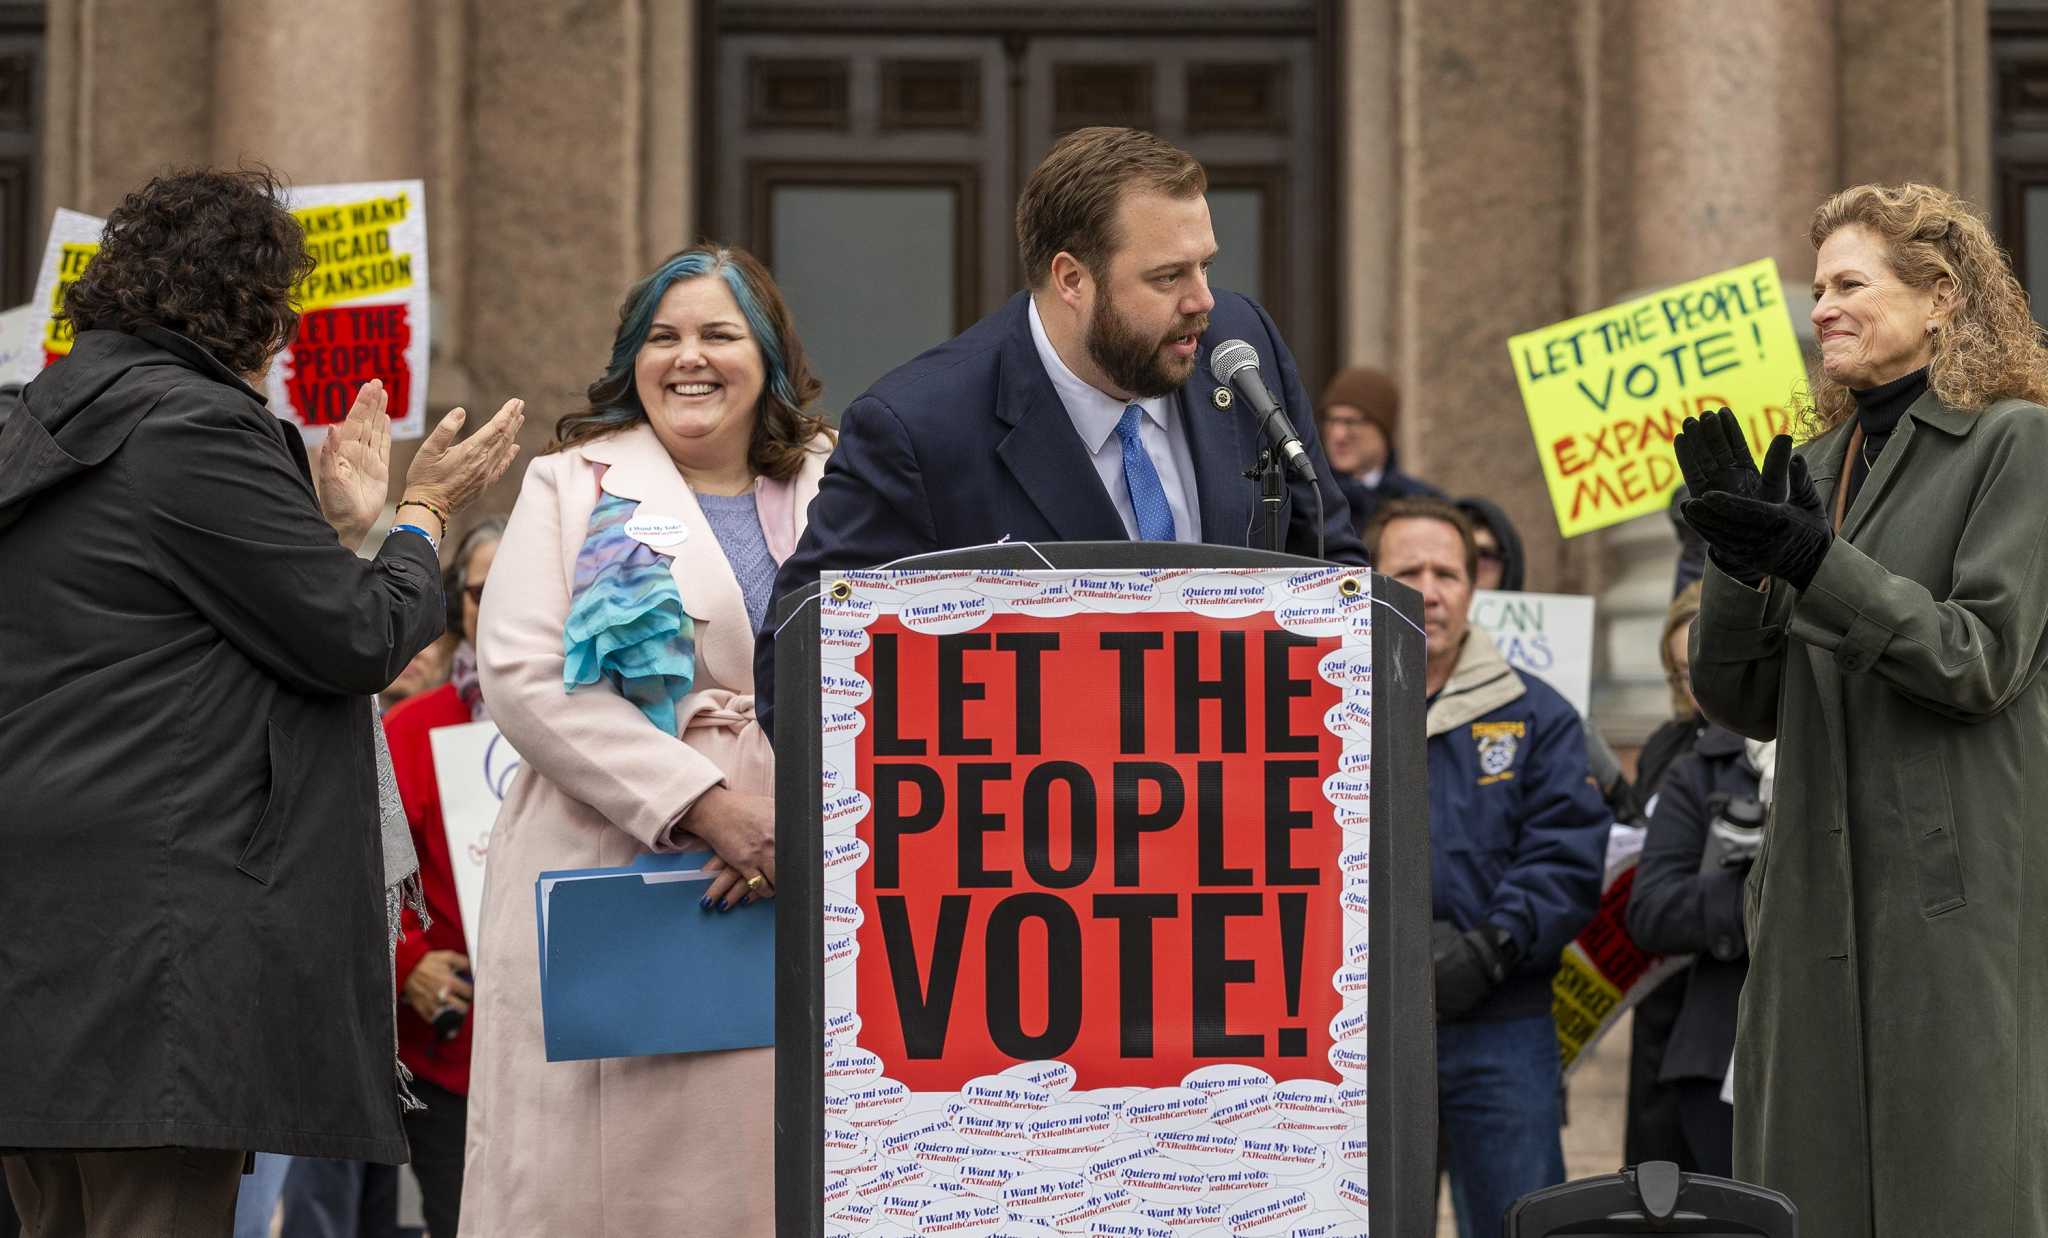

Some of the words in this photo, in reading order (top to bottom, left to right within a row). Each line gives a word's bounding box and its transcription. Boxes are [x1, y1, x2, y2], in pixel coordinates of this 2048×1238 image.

[306, 210, 342, 235] ANS
[353, 194, 408, 226] WANT
[305, 230, 390, 265] DICAID
[307, 254, 412, 298] PANSION
[351, 309, 401, 340] THE
[1524, 329, 1586, 382] LET
[1591, 305, 1657, 354] THE
[1660, 271, 1776, 334] PEOPLE
[295, 344, 401, 380] PEOPLE
[976, 576, 1040, 588] HealthCareVoter
[1080, 579, 1107, 590] Want
[1109, 580, 1126, 592] My
[1128, 582, 1154, 592] Vote!
[1287, 570, 1324, 588] ¡Quiero
[1073, 590, 1153, 601] #TXHealthCareVoter
[1183, 587, 1225, 597] ¡Quiero
[1227, 586, 1238, 596] mi
[1240, 586, 1265, 595] voto!
[847, 600, 872, 610] Vote!
[912, 607, 939, 617] Want
[941, 603, 958, 614] My
[960, 598, 985, 607] Vote!
[1185, 597, 1264, 605] #TXHealthCareVoter
[908, 609, 986, 626] #TXHealthCareVoter
[1280, 607, 1319, 618] ¡Quiero
[1322, 607, 1335, 615] mi
[1473, 600, 1545, 633] CAN
[838, 629, 863, 639] Vote!
[821, 676, 837, 686] My
[840, 678, 865, 688] Vote!
[873, 632, 1060, 756] LET
[1100, 630, 1319, 754] THE
[831, 712, 856, 723] Vote!
[1337, 782, 1362, 791] Want
[836, 793, 861, 806] Vote!
[873, 760, 1320, 889] PEOPLE
[835, 840, 859, 853] Vote!
[834, 906, 858, 915] voto!
[827, 937, 850, 951] Vote!
[876, 892, 1308, 1060] VOTE!
[829, 1012, 852, 1027] Vote!
[1341, 1013, 1364, 1030] Want
[836, 1058, 849, 1067] mi
[851, 1056, 876, 1066] voto!
[1043, 1066, 1067, 1079] voto!
[1187, 1080, 1225, 1089] ¡Quiero
[1228, 1077, 1240, 1086] mi
[1242, 1076, 1269, 1085] voto!
[862, 1090, 876, 1099] mi
[878, 1085, 903, 1096] voto!
[974, 1087, 1001, 1097] Want
[1004, 1089, 1021, 1100] My
[1024, 1093, 1049, 1102] Vote!
[1273, 1091, 1312, 1103] ¡Quiero
[1314, 1094, 1326, 1103] mi
[855, 1097, 903, 1109] lthCareVoter
[1126, 1104, 1165, 1117] ¡Quiero
[1167, 1101, 1180, 1110] mi
[1182, 1096, 1208, 1106] voto!
[1235, 1101, 1248, 1111] mi
[1028, 1119, 1068, 1132] ¡Quiero
[1069, 1116, 1082, 1125] mi
[1085, 1111, 1110, 1123] voto!
[1130, 1108, 1208, 1124] #TXHealthCareVoter
[965, 1118, 993, 1127] Want
[995, 1119, 1012, 1130] My
[1032, 1122, 1110, 1140] #TXHealthCareVoter
[834, 1130, 859, 1140] Vote!
[882, 1131, 920, 1148] ¡Quiero
[921, 1122, 934, 1134] mi
[1196, 1133, 1209, 1143] mi
[1212, 1136, 1237, 1146] voto!
[913, 1141, 953, 1153] ¡Quiero
[955, 1144, 969, 1154] mi
[1156, 1141, 1234, 1154] #TXHealthCareVoter
[1244, 1140, 1272, 1150] Want
[1273, 1142, 1290, 1153] My
[1292, 1145, 1317, 1155] Vote!
[1089, 1156, 1127, 1175] ¡Quiero
[1128, 1149, 1142, 1160] mi
[1242, 1151, 1315, 1164] TXHealthCareVoter
[880, 1169, 895, 1181] My
[967, 1167, 995, 1177] Want
[997, 1168, 1014, 1179] My
[1121, 1168, 1160, 1180] ¡Quiero
[1162, 1171, 1176, 1181] mi
[1179, 1173, 1205, 1184] voto!
[1228, 1172, 1241, 1181] mi
[824, 1178, 849, 1192] voto!
[1009, 1186, 1038, 1197] Want
[1039, 1183, 1056, 1196] My
[1058, 1179, 1084, 1190] Vote!
[1122, 1179, 1202, 1193] #TXHealthCareVoter
[1210, 1182, 1269, 1192] ealthCareVoter
[891, 1197, 918, 1208] Want
[1006, 1191, 1085, 1207] #TXHealthCareVoter
[1086, 1196, 1102, 1208] My
[847, 1205, 873, 1215] voto!
[925, 1214, 954, 1224] Want
[955, 1211, 972, 1221] My
[974, 1205, 999, 1216] Vote!
[1056, 1198, 1133, 1226] #TXHealthCareVoter
[1147, 1208, 1174, 1218] Want
[1177, 1207, 1193, 1217] My
[1195, 1204, 1221, 1214] Vote!
[1228, 1207, 1265, 1226] ¡Quiero
[1267, 1200, 1280, 1212] mi
[1282, 1192, 1306, 1206] voto!
[1167, 1216, 1221, 1226] althCareVoter
[1233, 1203, 1308, 1232] #TXHealthCareVoter
[922, 1217, 1000, 1234] #TXHealthCareVoter
[1098, 1223, 1126, 1235] Want
[1128, 1226, 1145, 1237] My
[1147, 1228, 1173, 1238] Vote!
[1298, 1226, 1326, 1237] Want
